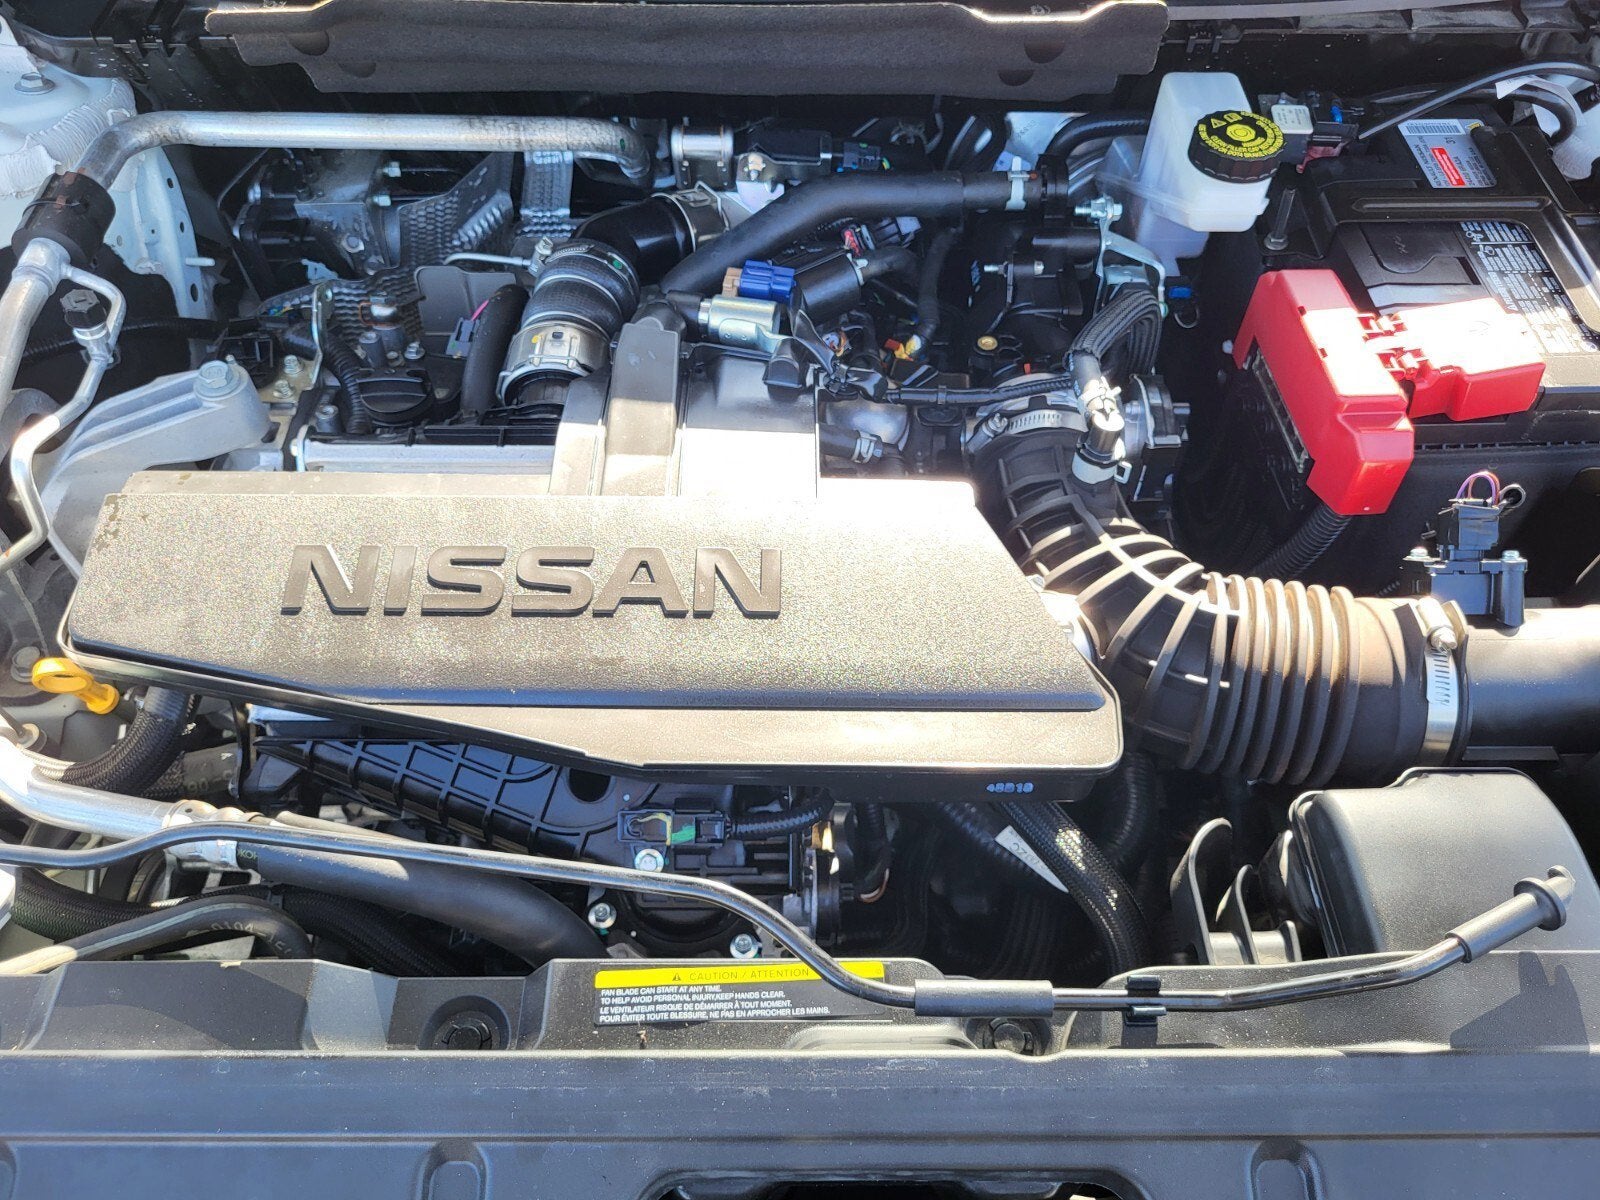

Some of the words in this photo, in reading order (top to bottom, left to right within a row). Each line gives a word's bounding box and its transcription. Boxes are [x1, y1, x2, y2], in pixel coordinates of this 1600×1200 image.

[280, 544, 782, 619] NISSAN
[689, 971, 738, 981] CAUTION
[750, 968, 809, 979] ATTENTION
[612, 996, 631, 1004] HELP
[631, 996, 652, 1004] AVOID
[653, 994, 691, 1003] PERSONAL
[734, 992, 760, 1000] HANDS
[760, 990, 785, 998] CLEAR.
[616, 988, 639, 996] BLADE
[640, 987, 655, 995] CAN
[656, 986, 677, 994] START
[688, 985, 704, 993] ANY
[600, 1006, 609, 1014] LE
[610, 1004, 655, 1014] VENTILATEUR
[656, 1003, 683, 1012] RISQUE
[684, 1002, 694, 1010] DE
[694, 1000, 733, 1010] DÉMARRER
[740, 1000, 759, 1008] TOUT
[760, 999, 792, 1008] MOMENT.
[600, 1014, 621, 1023] POUR
[621, 1012, 646, 1022] ÉVITER
[646, 1012, 669, 1020] TOUTE
[670, 1010, 708, 1020] BLESSURE,
[709, 1010, 720, 1018] NE
[720, 1008, 735, 1018] PAS
[736, 1008, 746, 1017] EN
[746, 1007, 791, 1016] APPROCHER
[792, 1006, 805, 1014] LES
[806, 1006, 830, 1014] MAINS.
